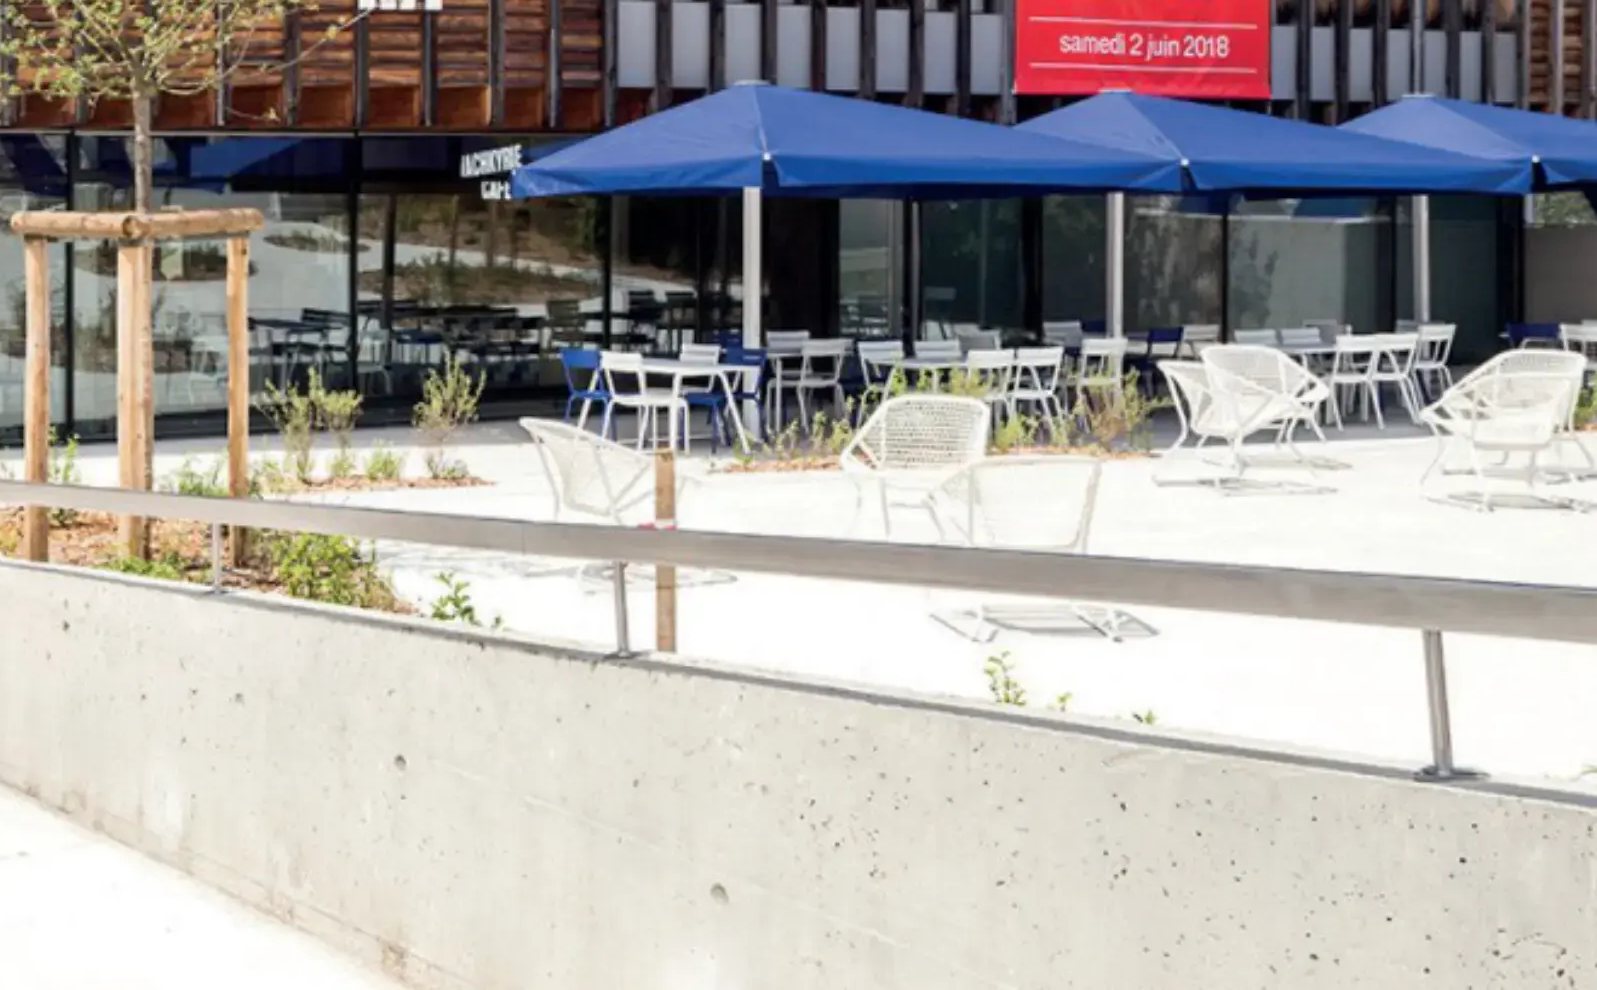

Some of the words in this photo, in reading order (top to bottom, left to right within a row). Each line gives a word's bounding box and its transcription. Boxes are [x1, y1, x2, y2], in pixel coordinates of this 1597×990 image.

[1059, 32, 1126, 55] samedi
[1129, 33, 1144, 56] 2
[1144, 34, 1179, 61] juin
[1183, 35, 1230, 58] 2018
